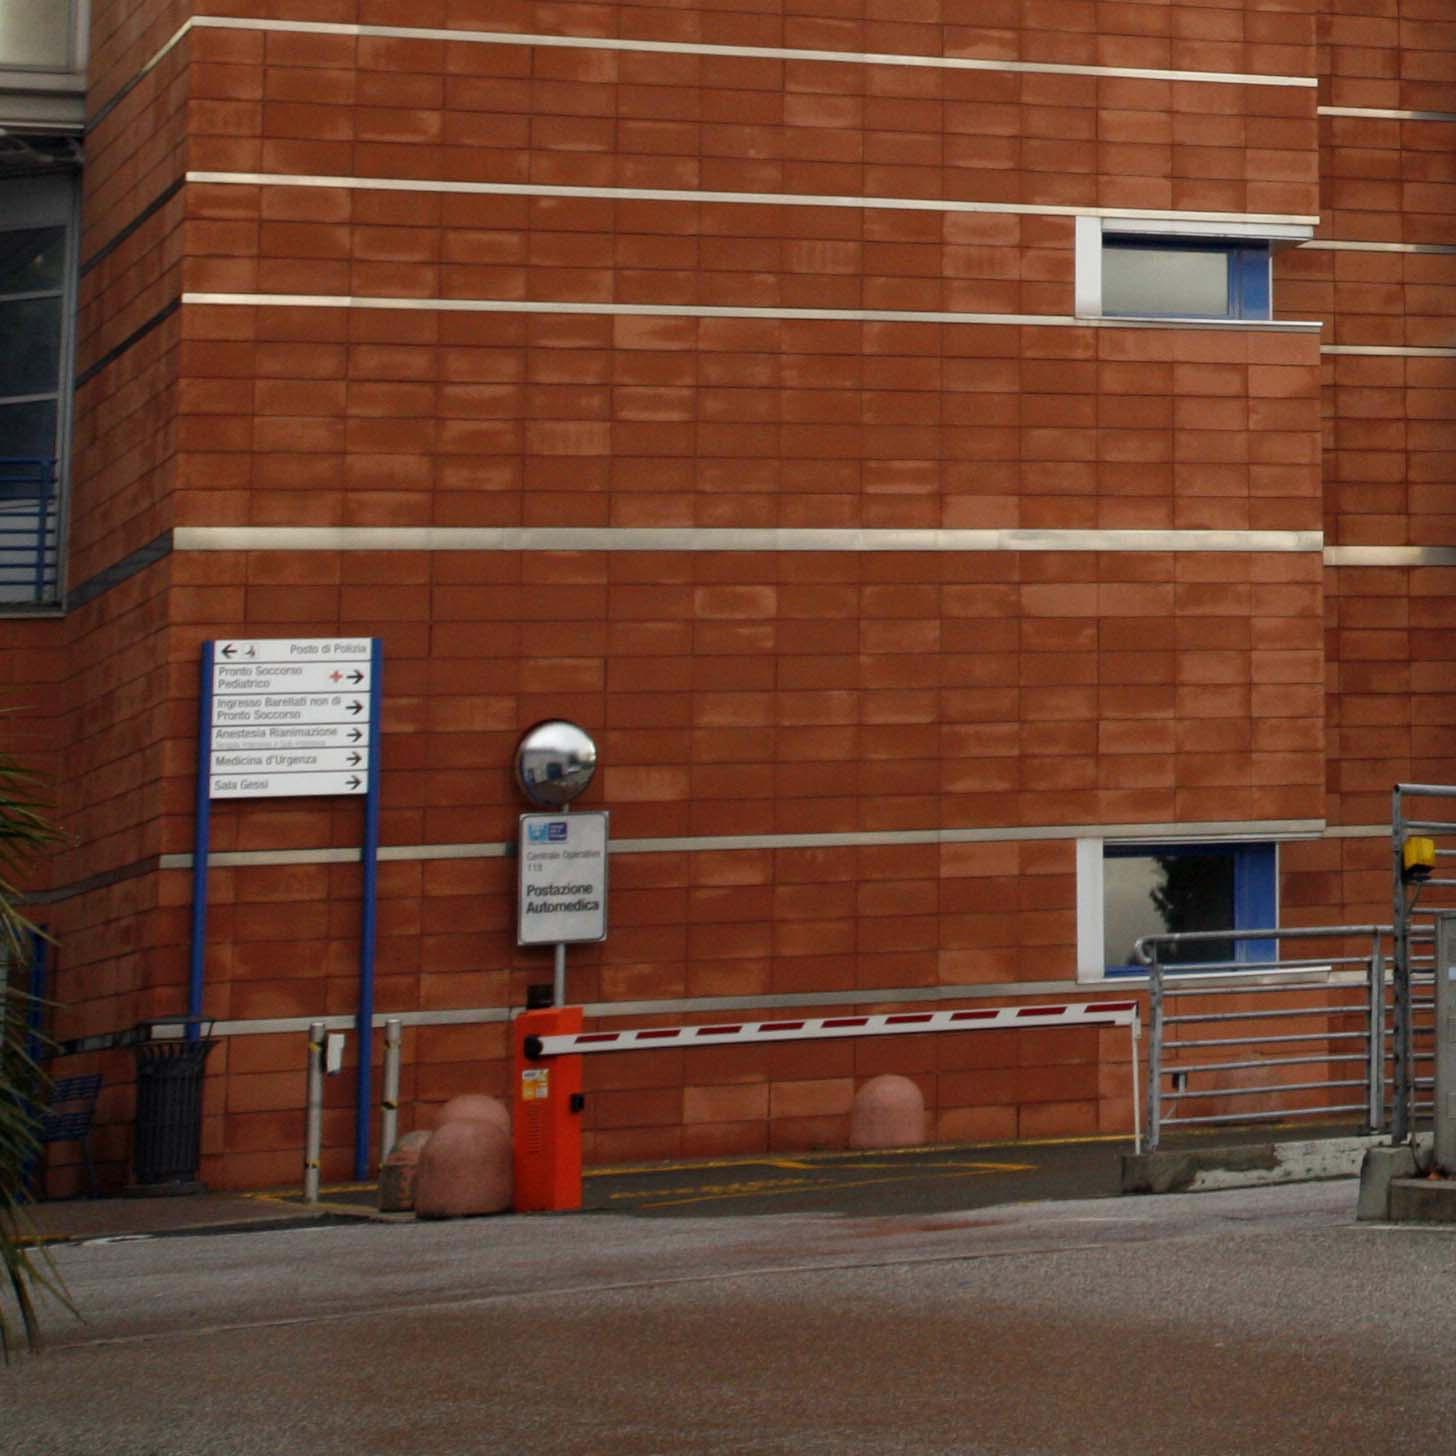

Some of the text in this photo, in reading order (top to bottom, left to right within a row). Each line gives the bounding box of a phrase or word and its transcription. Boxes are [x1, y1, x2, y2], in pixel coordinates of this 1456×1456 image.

[334, 643, 367, 655] Polizia
[218, 664, 303, 676] Pronto Soccorso
[218, 678, 271, 689] Pediatrico
[217, 698, 262, 710] Ingresso
[310, 698, 329, 706] non
[331, 695, 342, 705] di
[217, 709, 301, 721] Pronto Soccorso
[216, 727, 266, 739] Anestesia
[215, 754, 318, 767] Medicina d'Urgenza
[214, 780, 238, 792] Sala
[526, 883, 593, 897] Postazione
[526, 899, 600, 914] Automedica
